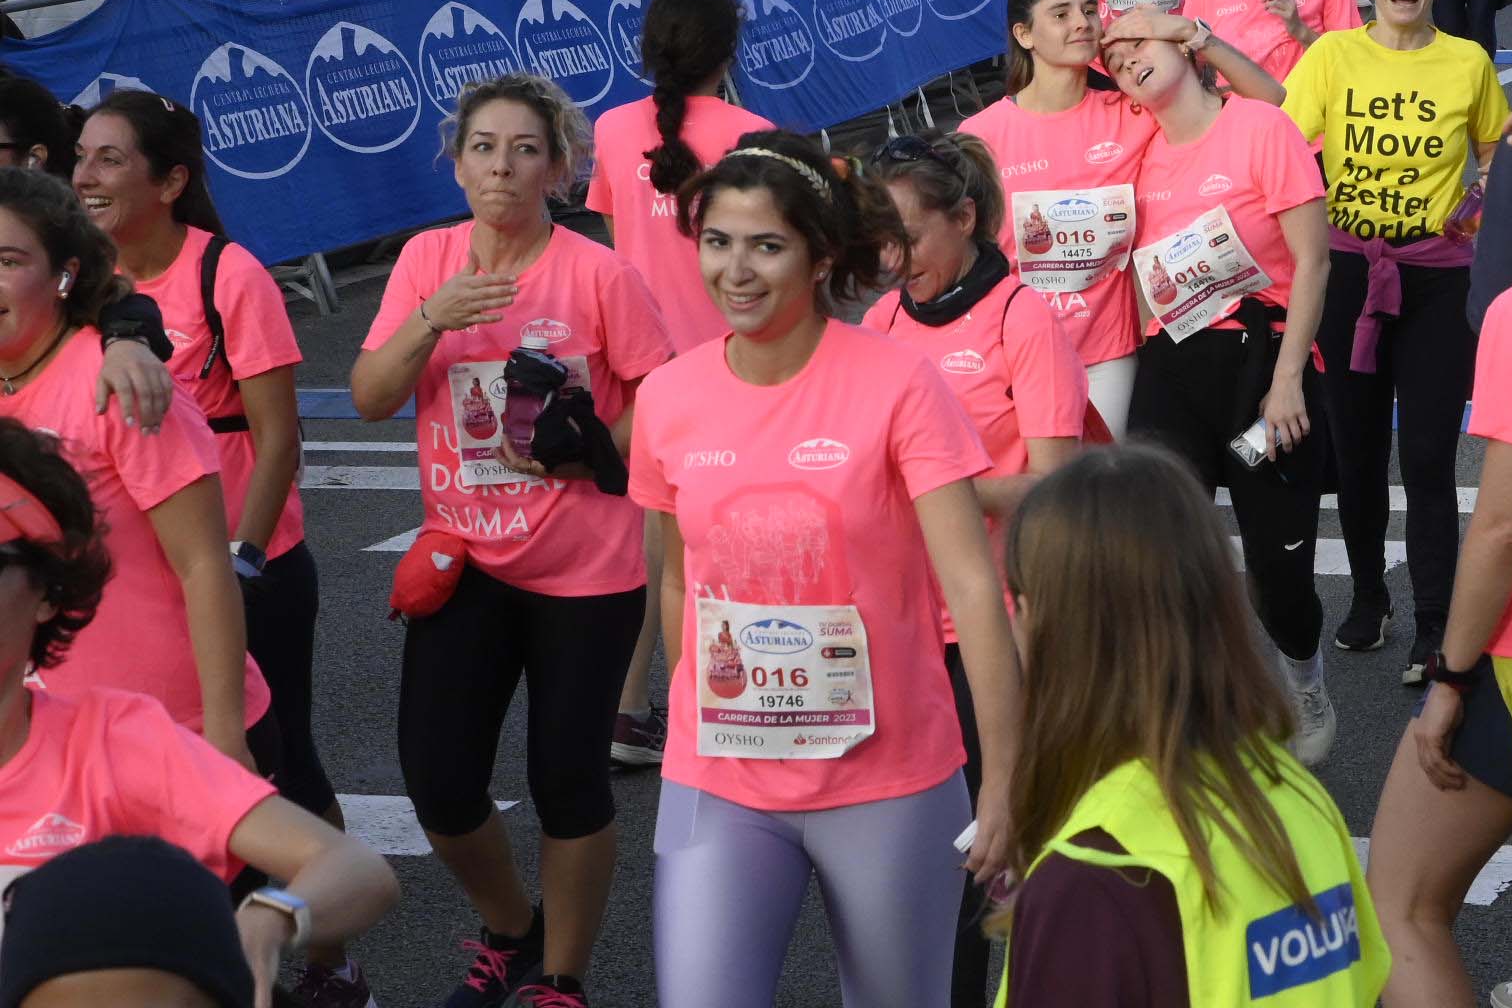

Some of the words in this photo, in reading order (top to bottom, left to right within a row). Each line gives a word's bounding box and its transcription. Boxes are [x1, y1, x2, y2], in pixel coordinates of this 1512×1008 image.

[326, 65, 362, 84] CENTRAL
[365, 59, 400, 78] LECHERA
[212, 90, 249, 107] CENTRAL
[252, 82, 290, 100] LECHERA
[321, 77, 416, 127] ASTURIANA
[1345, 88, 1436, 122] Let's
[203, 100, 306, 152] ASTURIANA
[1344, 124, 1444, 157] Move
[1001, 159, 1049, 178] OYSHO
[1343, 156, 1389, 182] for
[1398, 167, 1420, 185] a
[1335, 181, 1430, 218] Better
[1049, 206, 1098, 218] ASTURIANA
[1332, 205, 1427, 241] World
[1056, 229, 1096, 245] 016
[1061, 247, 1093, 258] 14475
[1032, 262, 1064, 270] CARRERA
[1174, 259, 1211, 285] 016
[1031, 276, 1066, 285] OYSHO
[1171, 301, 1198, 320] CARRERA
[1177, 308, 1209, 332] OYSHO
[437, 503, 529, 538] SUMA
[745, 631, 808, 647] ASTURIANA
[819, 627, 853, 637] SUMA
[751, 666, 809, 688] 016
[758, 695, 805, 708] 19746
[718, 713, 763, 723] CARRERA
[764, 714, 778, 723] DE
[780, 714, 793, 723] LA
[795, 714, 829, 723] MUJER
[833, 713, 857, 722] 2023
[715, 732, 765, 748] OYSHO
